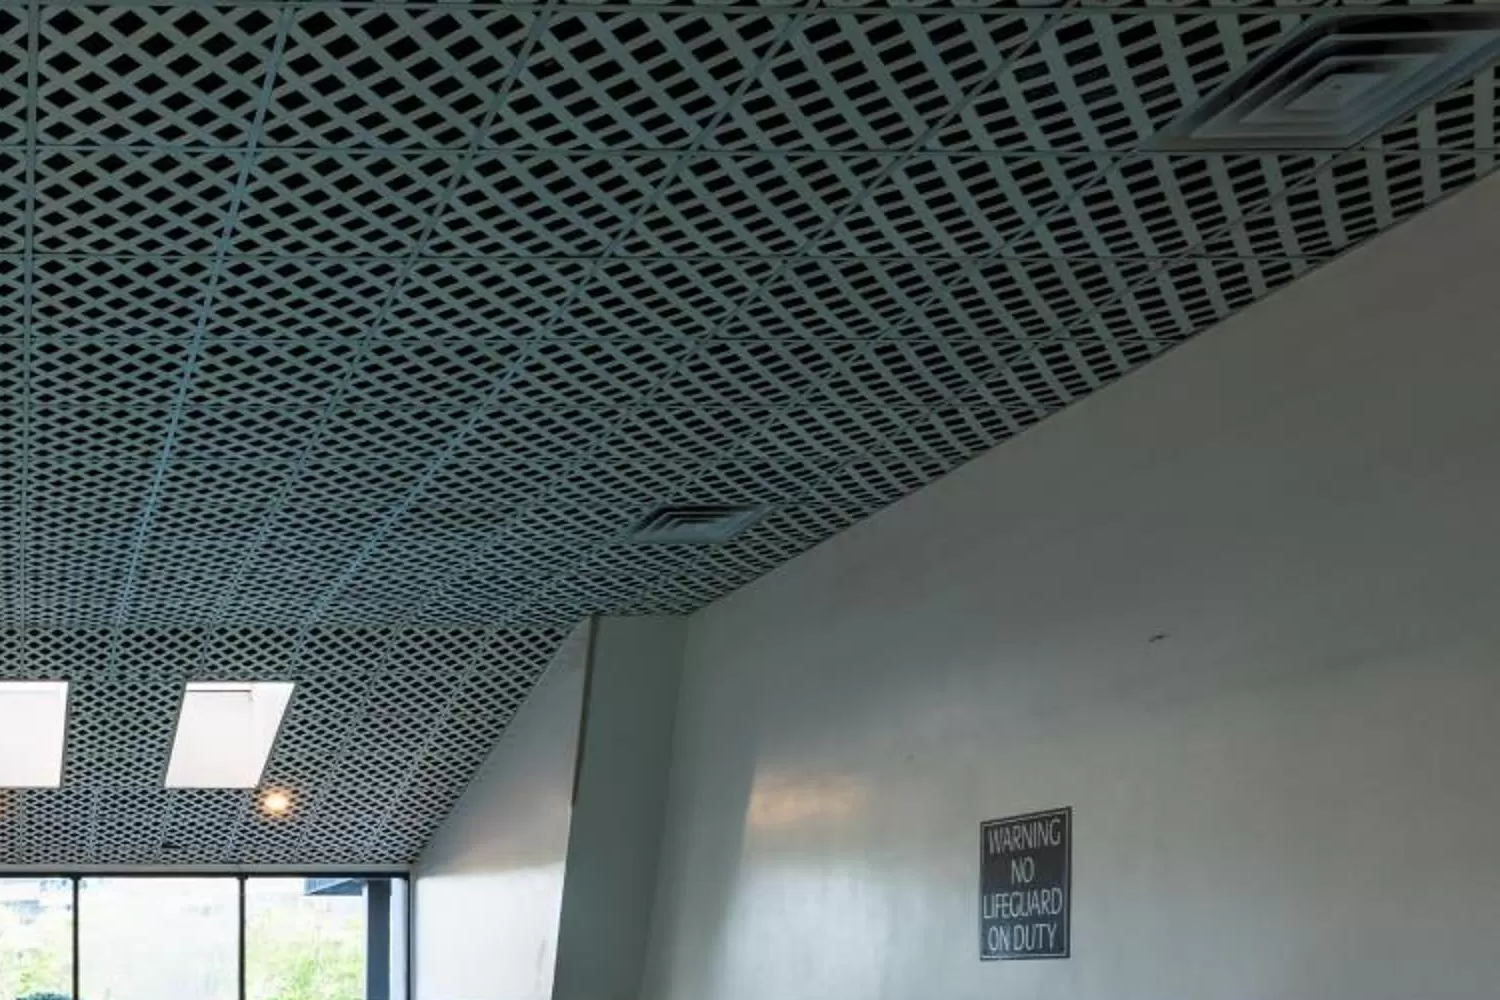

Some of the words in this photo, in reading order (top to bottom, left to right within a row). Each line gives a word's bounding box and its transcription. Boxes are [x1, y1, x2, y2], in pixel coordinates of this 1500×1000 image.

[988, 818, 1061, 855] WARNING
[1011, 856, 1035, 884] NO
[983, 887, 1062, 919] LIFEGUARD
[988, 925, 1009, 952] ON
[1013, 922, 1057, 951] DUTY
